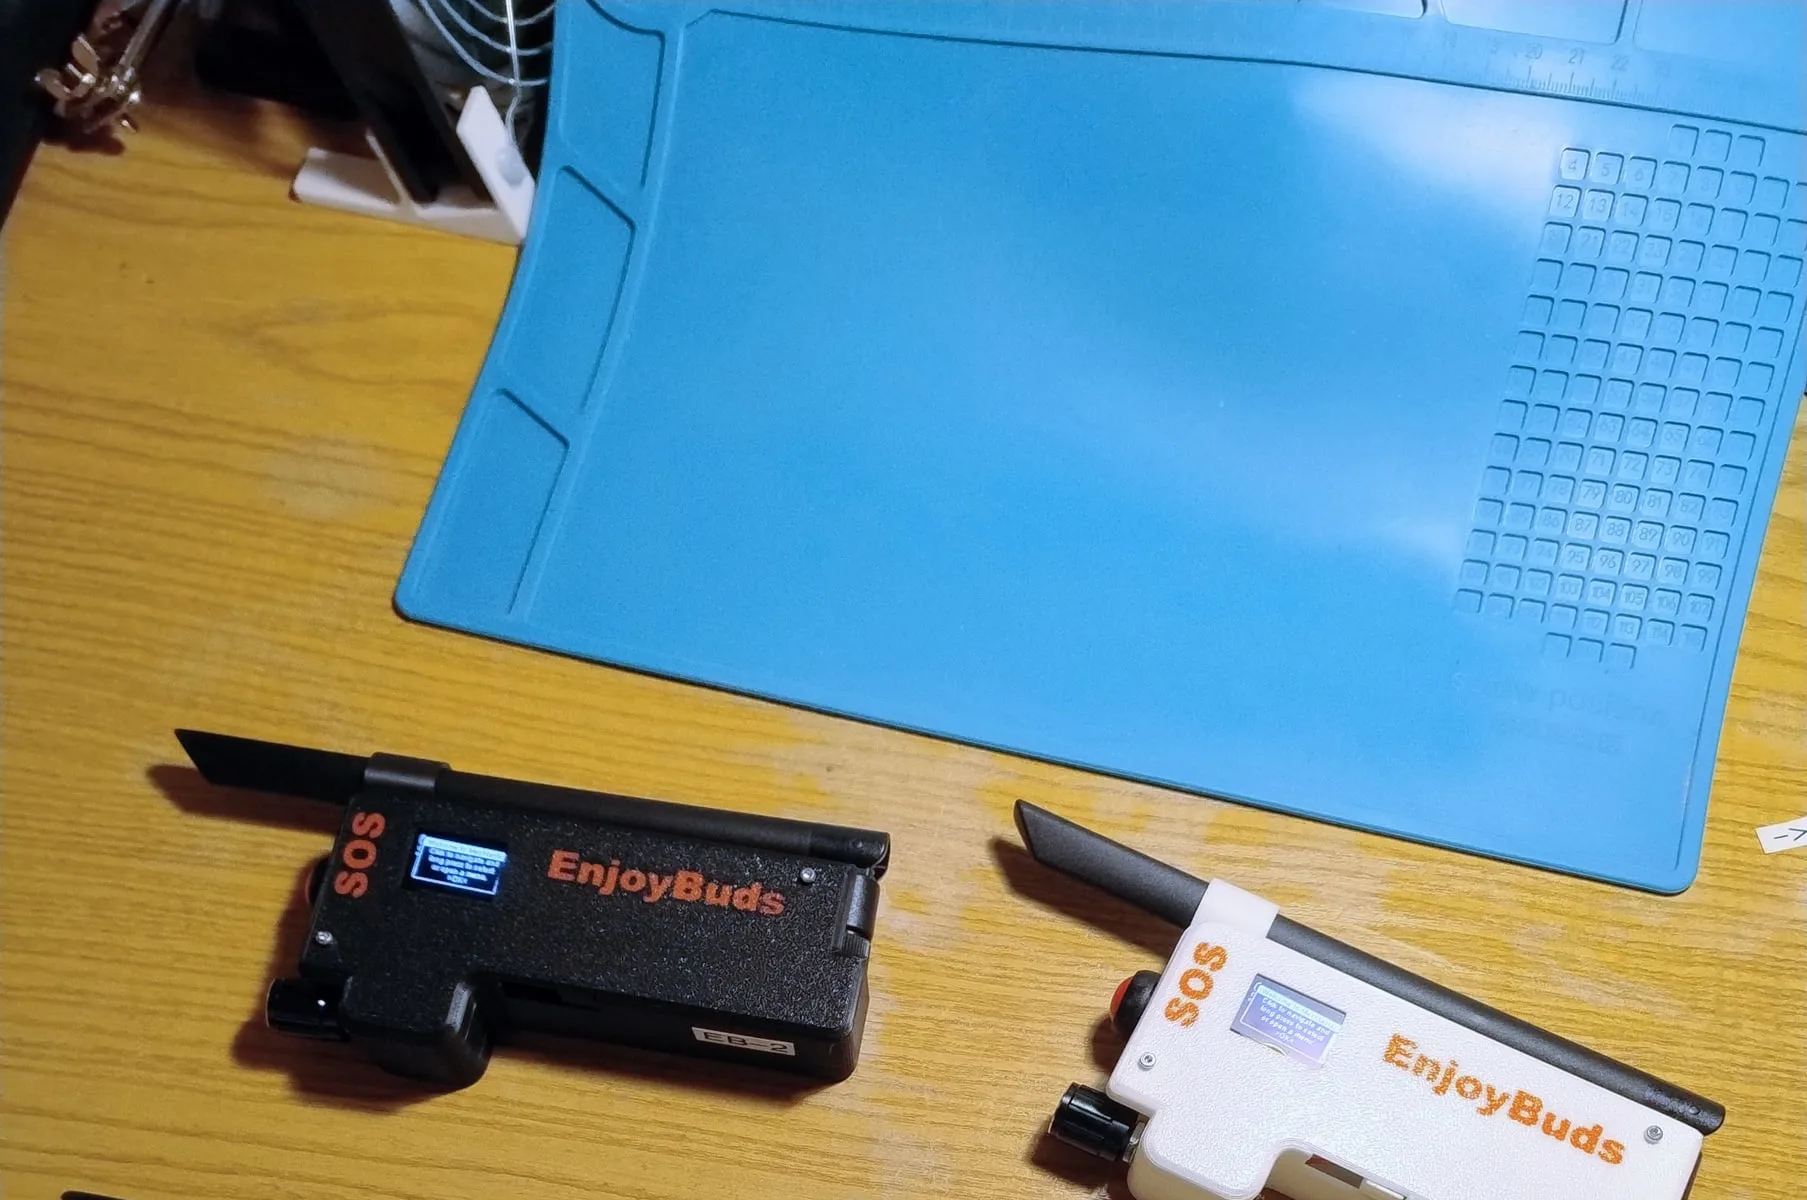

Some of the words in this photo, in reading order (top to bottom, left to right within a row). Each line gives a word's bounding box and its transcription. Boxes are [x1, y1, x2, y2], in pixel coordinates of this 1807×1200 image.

[1523, 44, 1542, 60] 20
[1568, 48, 1585, 64] 21
[1567, 159, 1577, 171] 4
[1601, 163, 1610, 176] 5
[1634, 168, 1644, 181] 6
[1556, 194, 1574, 210] 12
[1589, 198, 1606, 214] 13
[1623, 457, 1640, 472] 72
[1655, 461, 1673, 476] 73
[1583, 485, 1600, 500] 79
[1614, 490, 1633, 506] 80
[1646, 494, 1663, 509] 81
[1574, 516, 1592, 532] 87
[1607, 522, 1625, 537] 88
[1672, 531, 1690, 547] 90
[1567, 549, 1584, 565] 95
[1599, 554, 1617, 570] 96
[1631, 558, 1650, 574] 97
[1664, 564, 1682, 579] 98
[1624, 589, 1644, 605] 105
[334, 811, 386, 899] SOS
[548, 849, 786, 916] EnjoyBuds
[1164, 941, 1228, 1028] SOS
[703, 1031, 788, 1054] EB-2
[1383, 1032, 1625, 1166] EnjoyBuds
